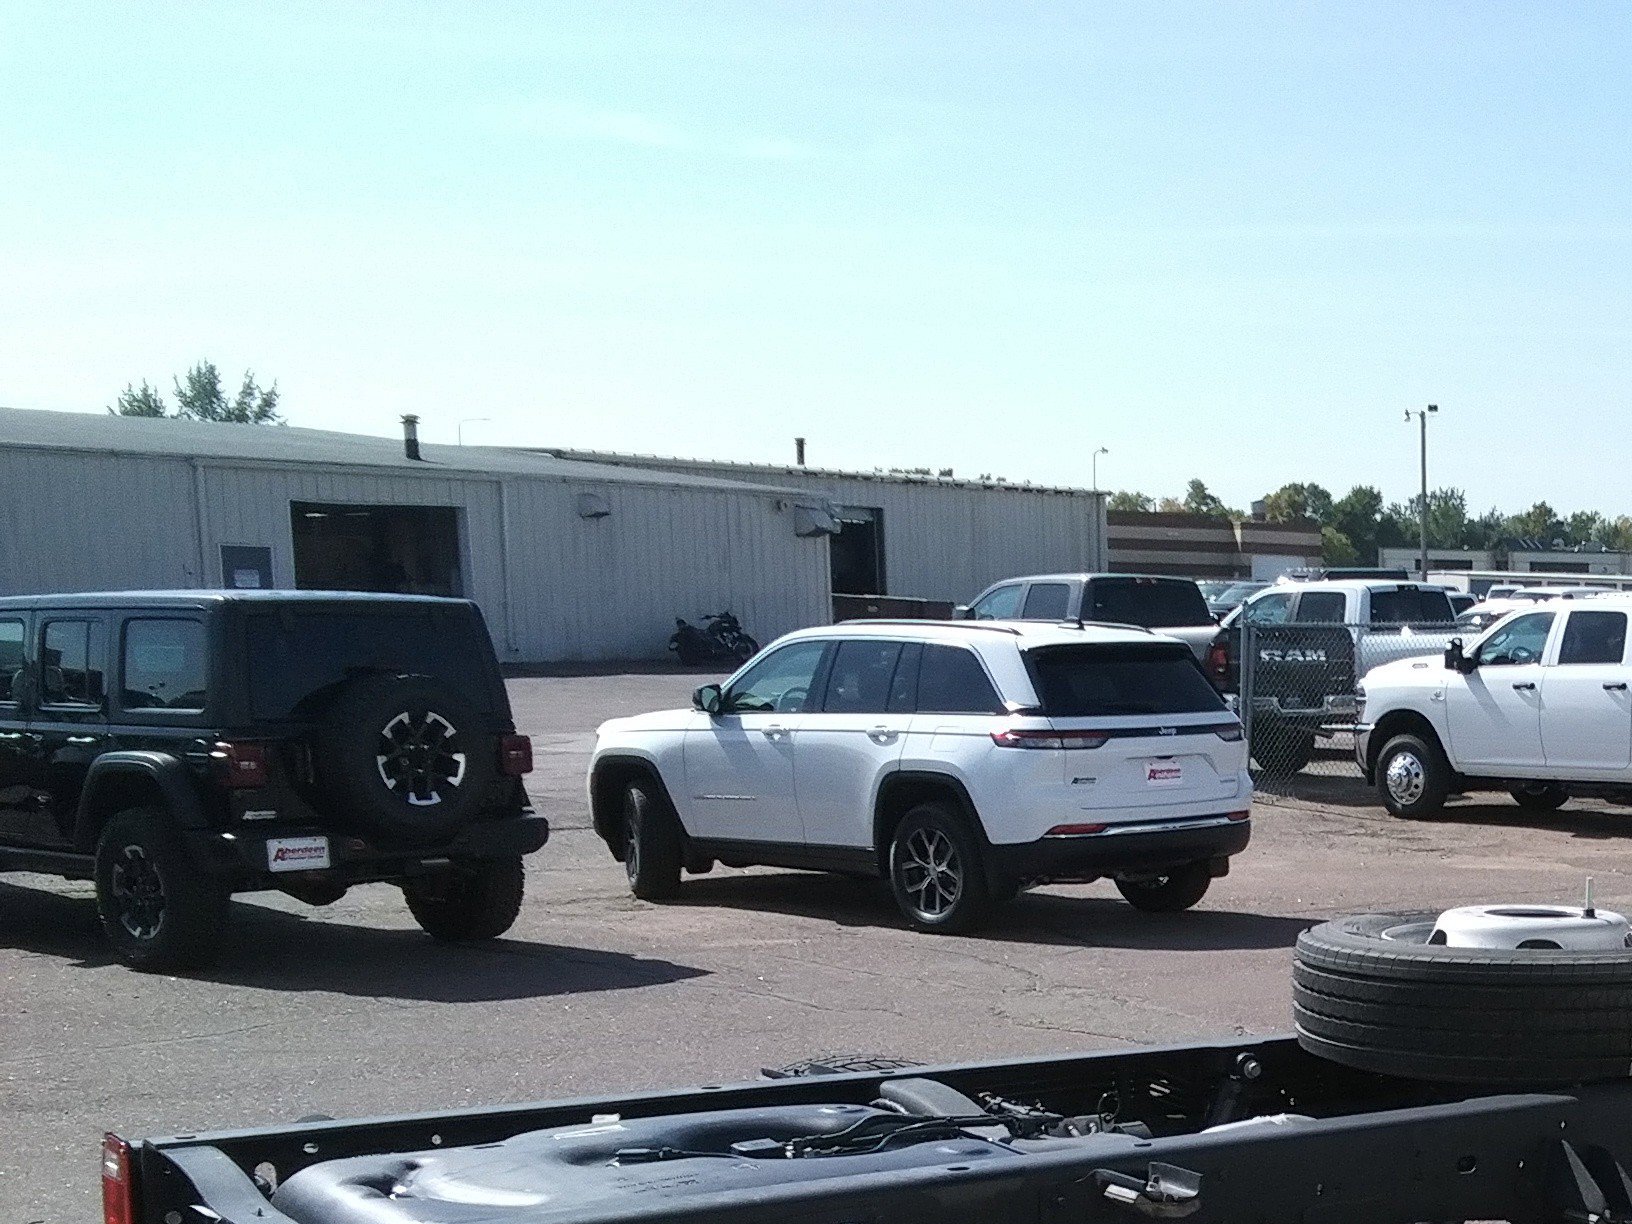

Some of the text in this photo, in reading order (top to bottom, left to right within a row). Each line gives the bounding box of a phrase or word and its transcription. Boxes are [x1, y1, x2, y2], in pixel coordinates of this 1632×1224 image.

[1260, 649, 1326, 661] RAM
[1159, 726, 1177, 737] Jeep
[273, 847, 325, 862] Aberdeen
